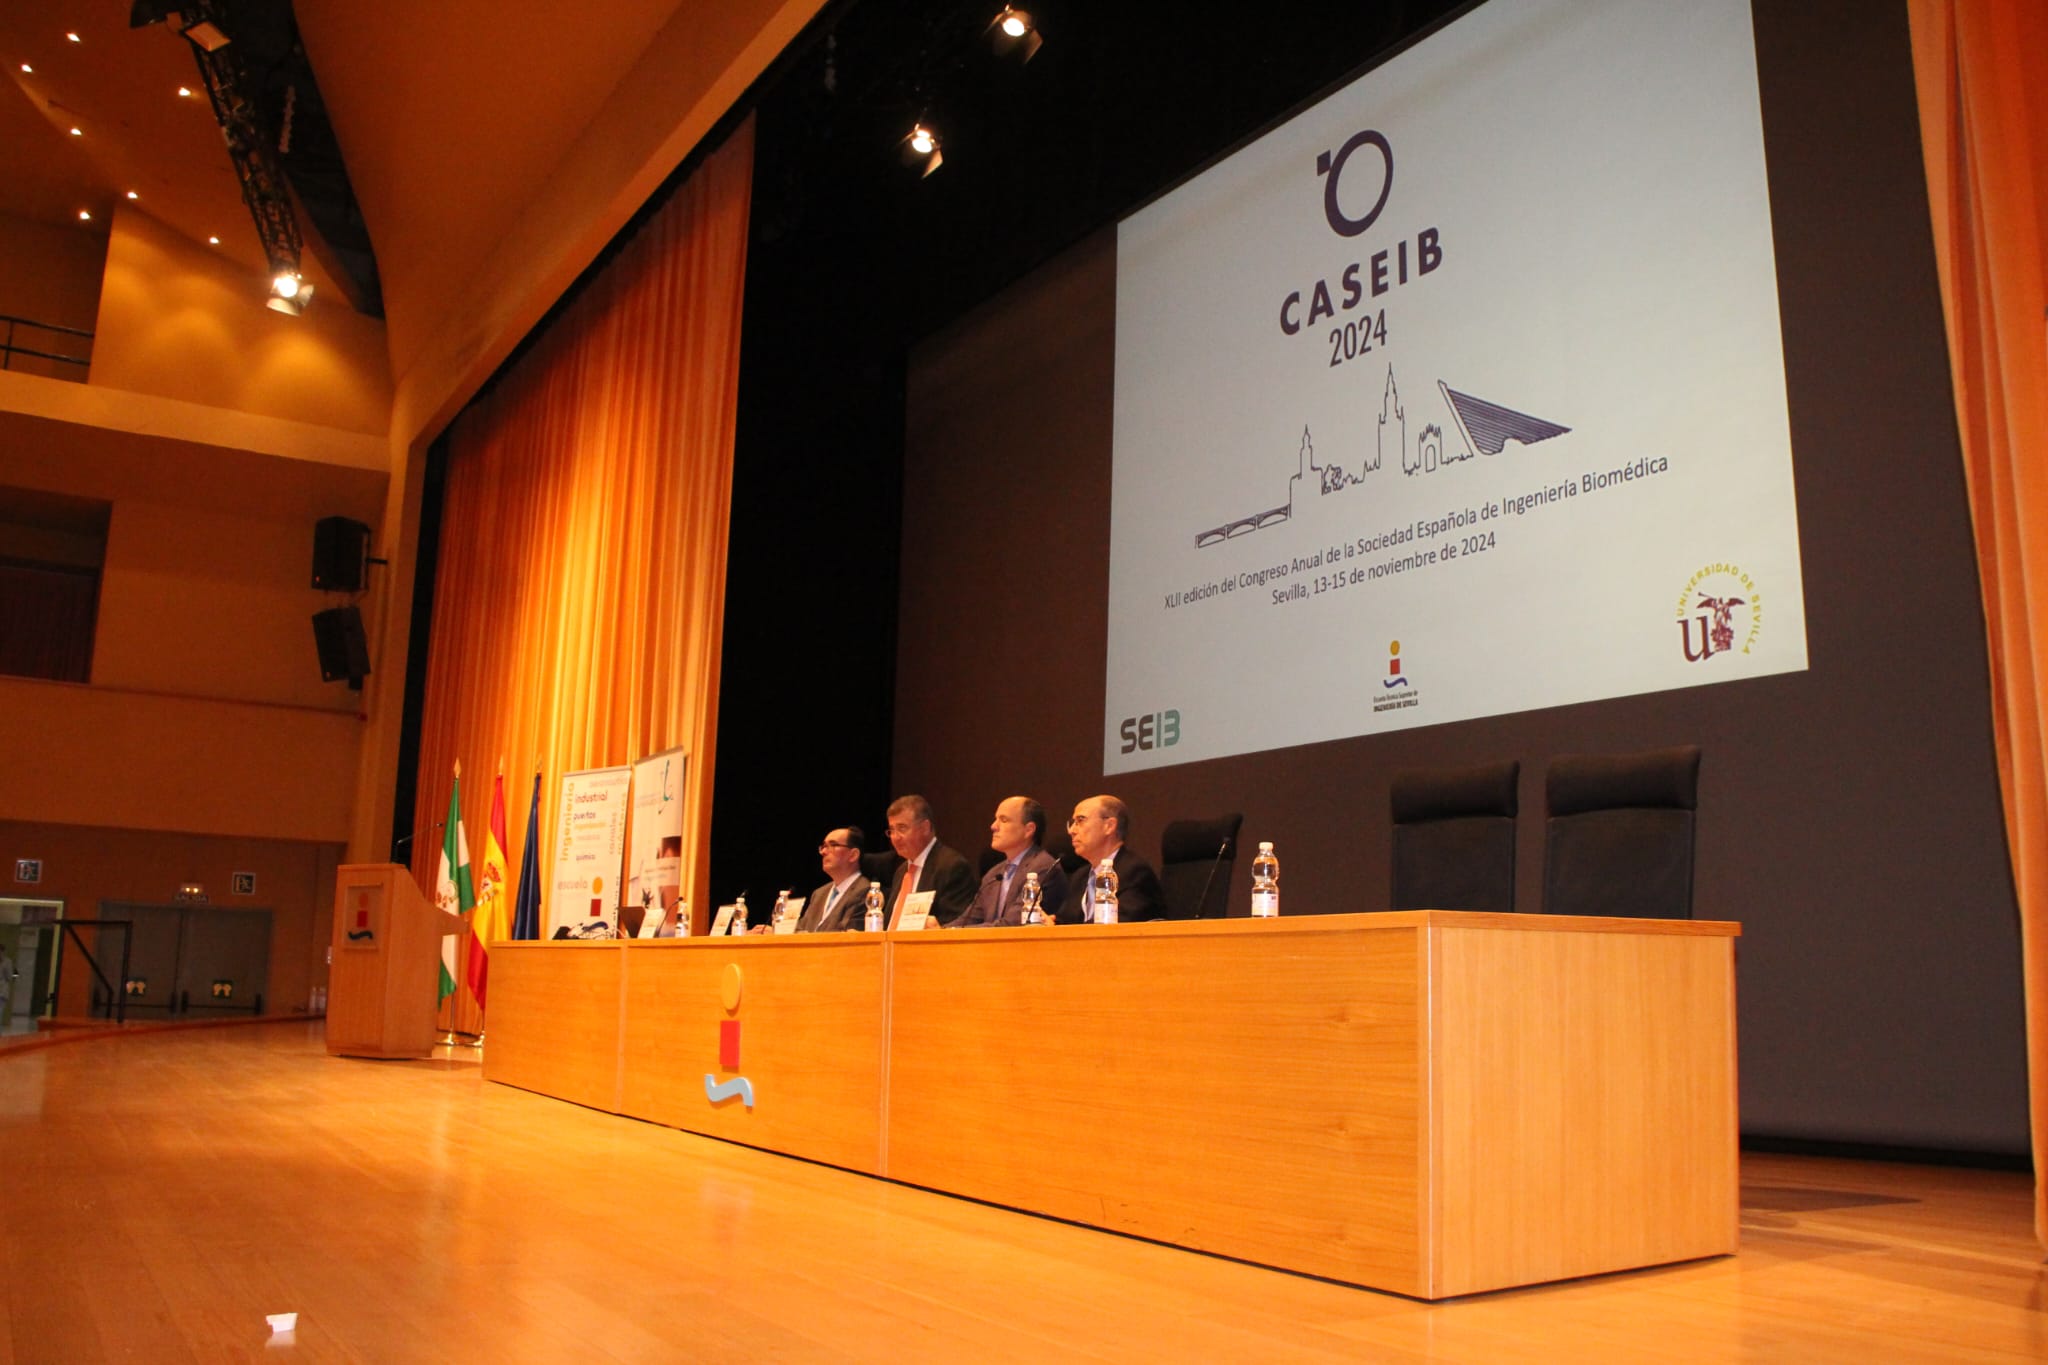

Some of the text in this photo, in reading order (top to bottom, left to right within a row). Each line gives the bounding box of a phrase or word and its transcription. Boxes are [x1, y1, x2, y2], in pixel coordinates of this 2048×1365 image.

[1280, 227, 1442, 335] CASEIB
[1329, 308, 1387, 367] 2024
[1183, 582, 1218, 605] edición
[1221, 578, 1237, 594] del
[1239, 563, 1288, 589] Congreso
[1291, 550, 1323, 574] Anual
[1326, 546, 1341, 563] de
[1344, 541, 1354, 558] la
[1357, 524, 1413, 555] Sociedad
[1417, 510, 1477, 539] Española
[1481, 502, 1498, 520] de
[1503, 480, 1577, 515] Ingeniería
[1582, 456, 1668, 493] Biomédica
[1272, 531, 1496, 605] Sevilla, 13-15 de noviembre de 2024
[1676, 563, 1761, 655] UNIVERSIDAD DE SEVILLA
[575, 789, 608, 803] industrial
